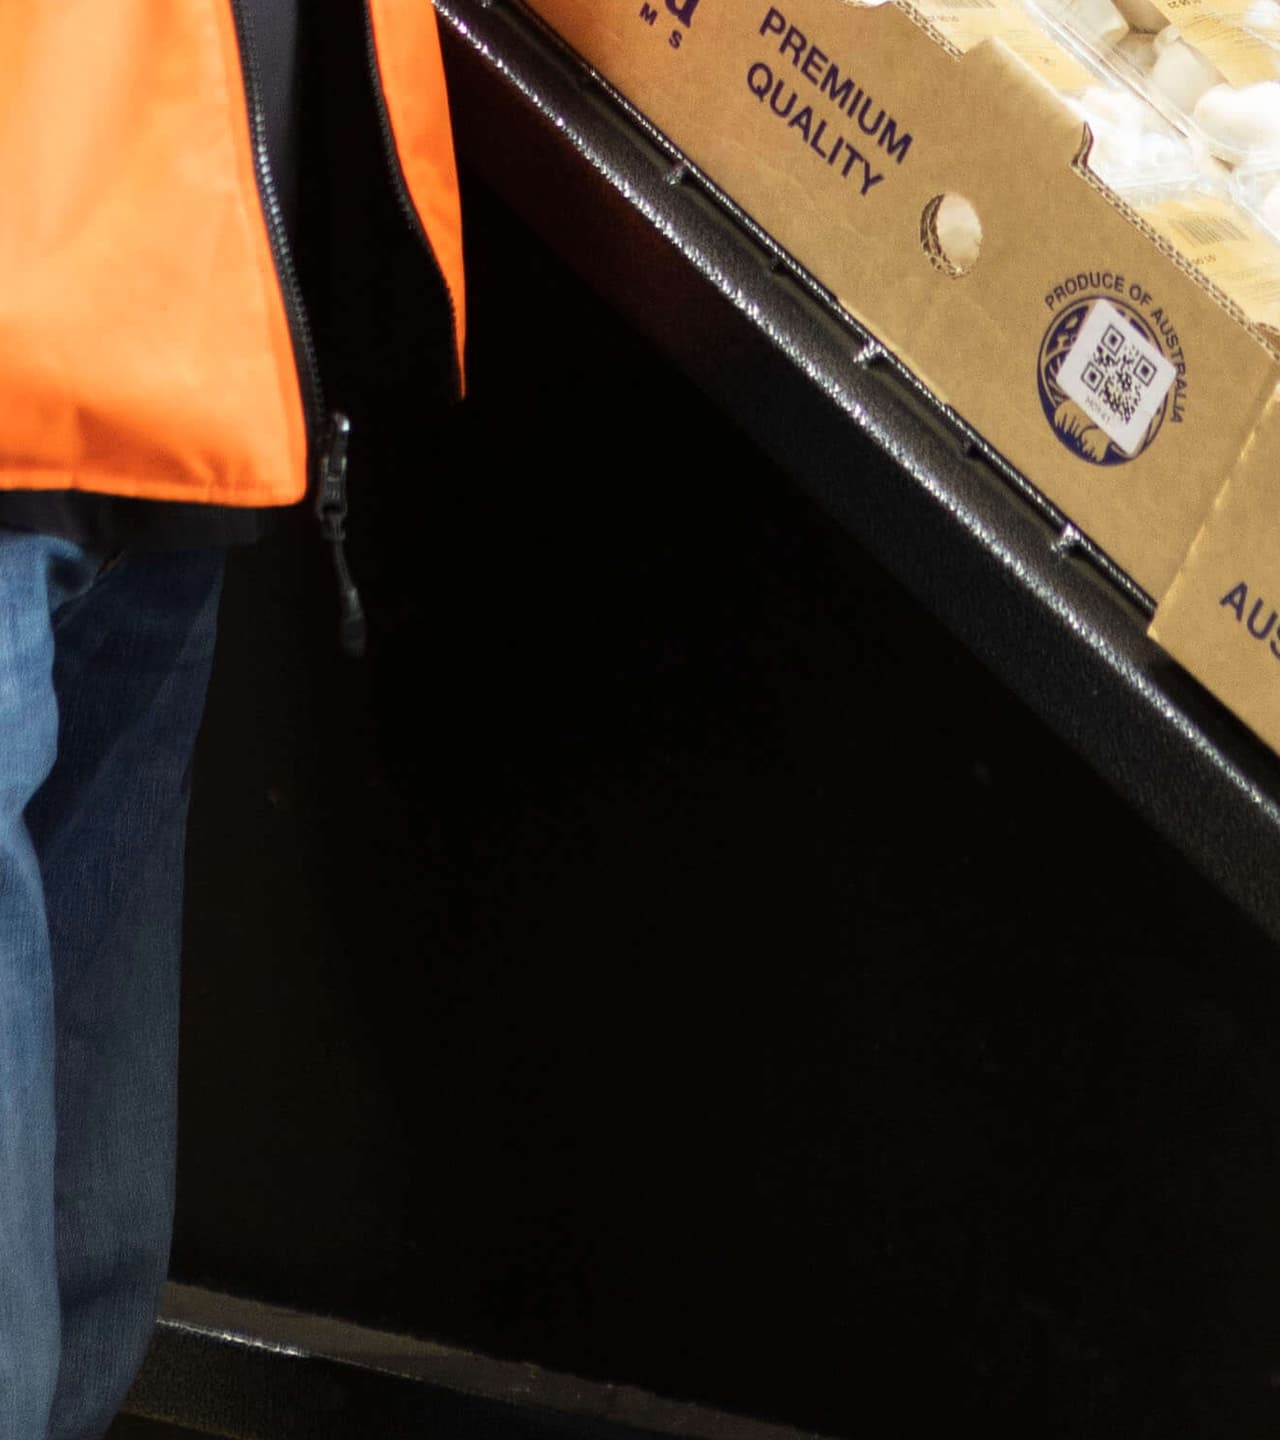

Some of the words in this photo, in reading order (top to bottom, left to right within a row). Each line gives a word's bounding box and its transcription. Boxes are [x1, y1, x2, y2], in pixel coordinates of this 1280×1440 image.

[745, 62, 885, 198] QUALITY
[758, 6, 914, 166] PREMIUM
[1043, 271, 1126, 312] PRODUCE
[1128, 283, 1153, 307] OF
[1150, 307, 1188, 424] AUSTRALIA
